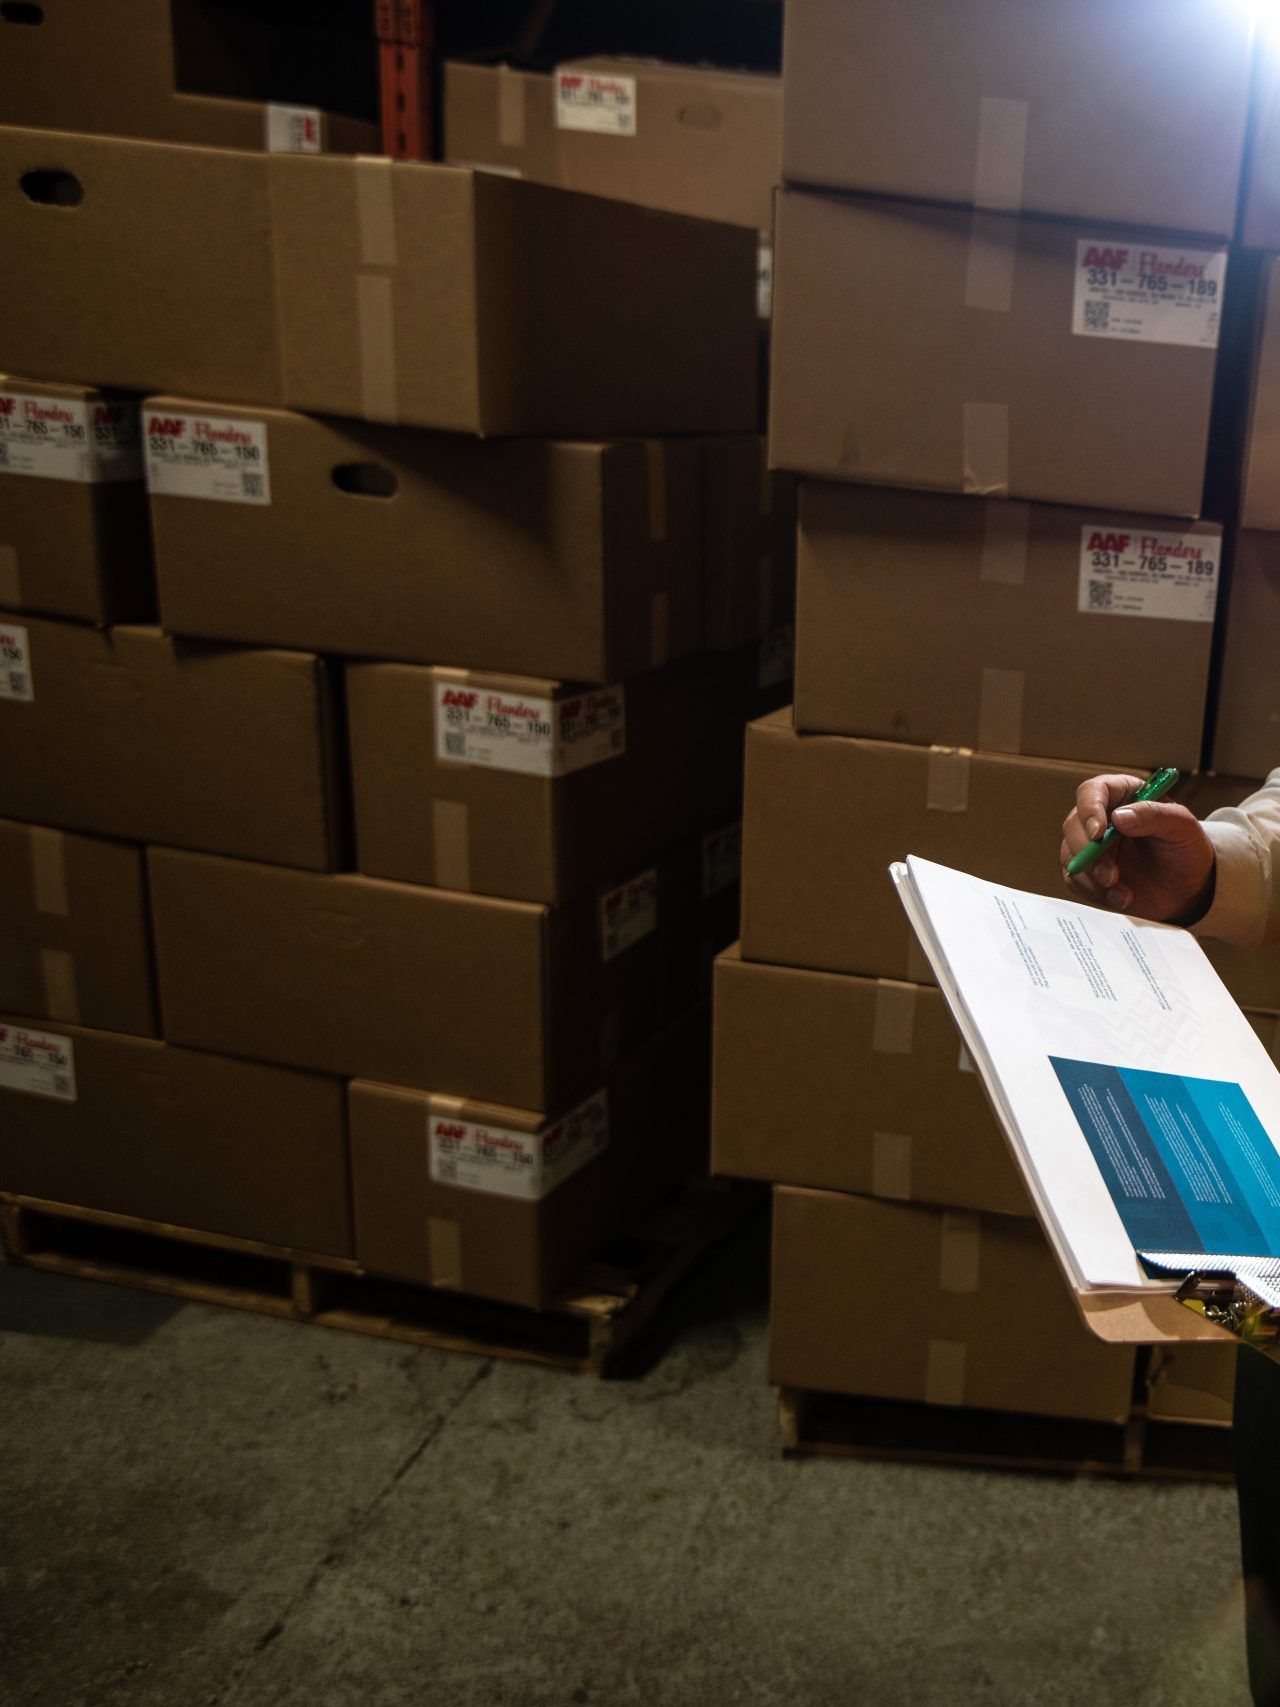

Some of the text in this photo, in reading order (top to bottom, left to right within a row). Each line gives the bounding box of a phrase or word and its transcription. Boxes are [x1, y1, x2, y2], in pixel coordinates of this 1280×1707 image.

[1082, 246, 1206, 279] AAF Flanders
[1087, 532, 1204, 560] AAF Flanders
[443, 690, 478, 709] AAF
